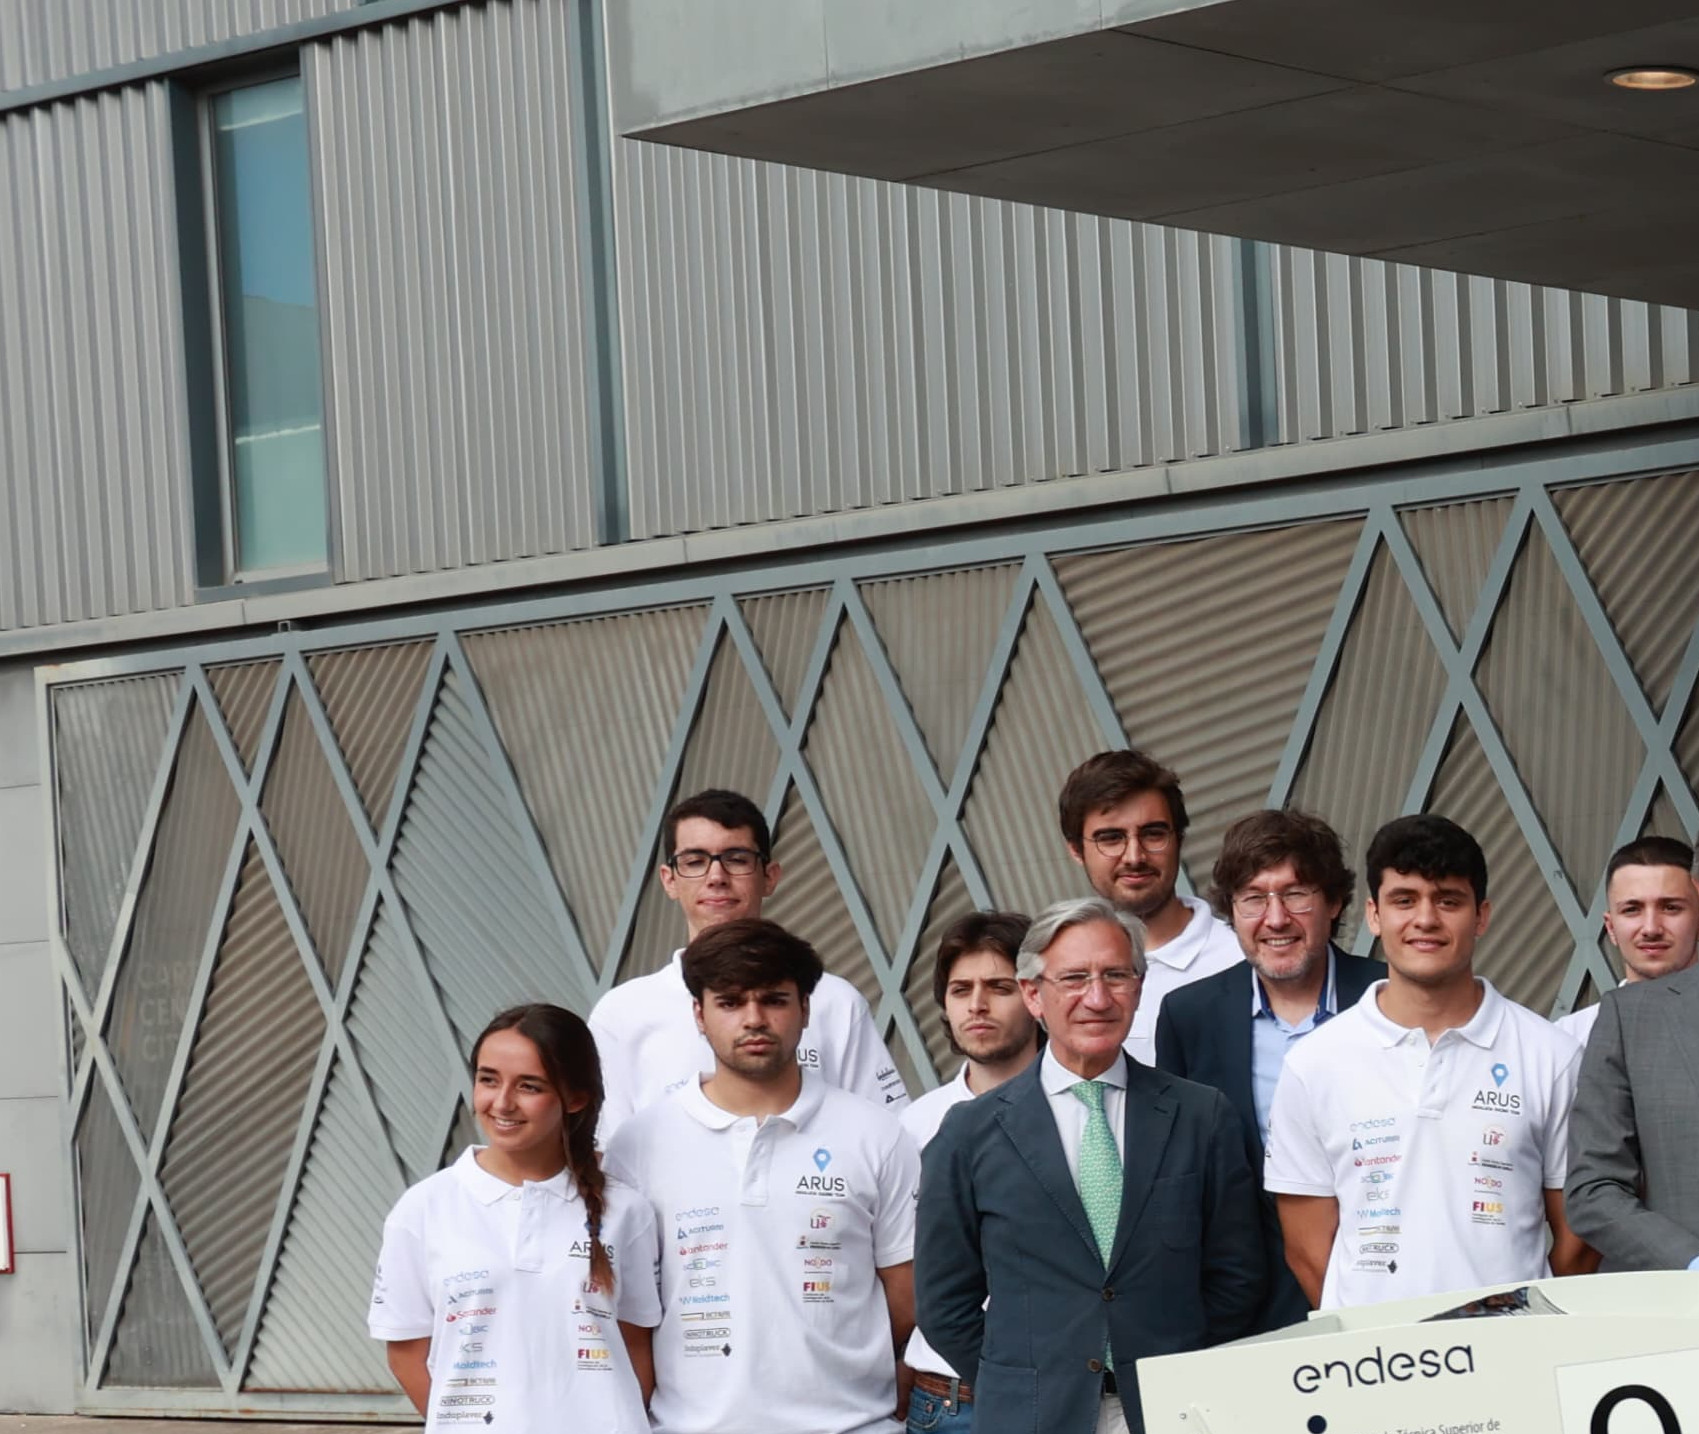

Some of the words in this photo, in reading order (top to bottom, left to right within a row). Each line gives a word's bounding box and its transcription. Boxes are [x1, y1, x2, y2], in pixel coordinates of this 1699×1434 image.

[797, 1049, 819, 1063] US
[1474, 1090, 1521, 1109] ARUS
[796, 1176, 845, 1192] ARUS
[803, 1282, 830, 1292] FIUS
[578, 1349, 609, 1359] FIUS
[1293, 1345, 1474, 1394] endesa
[1487, 1418, 1500, 1432] de
